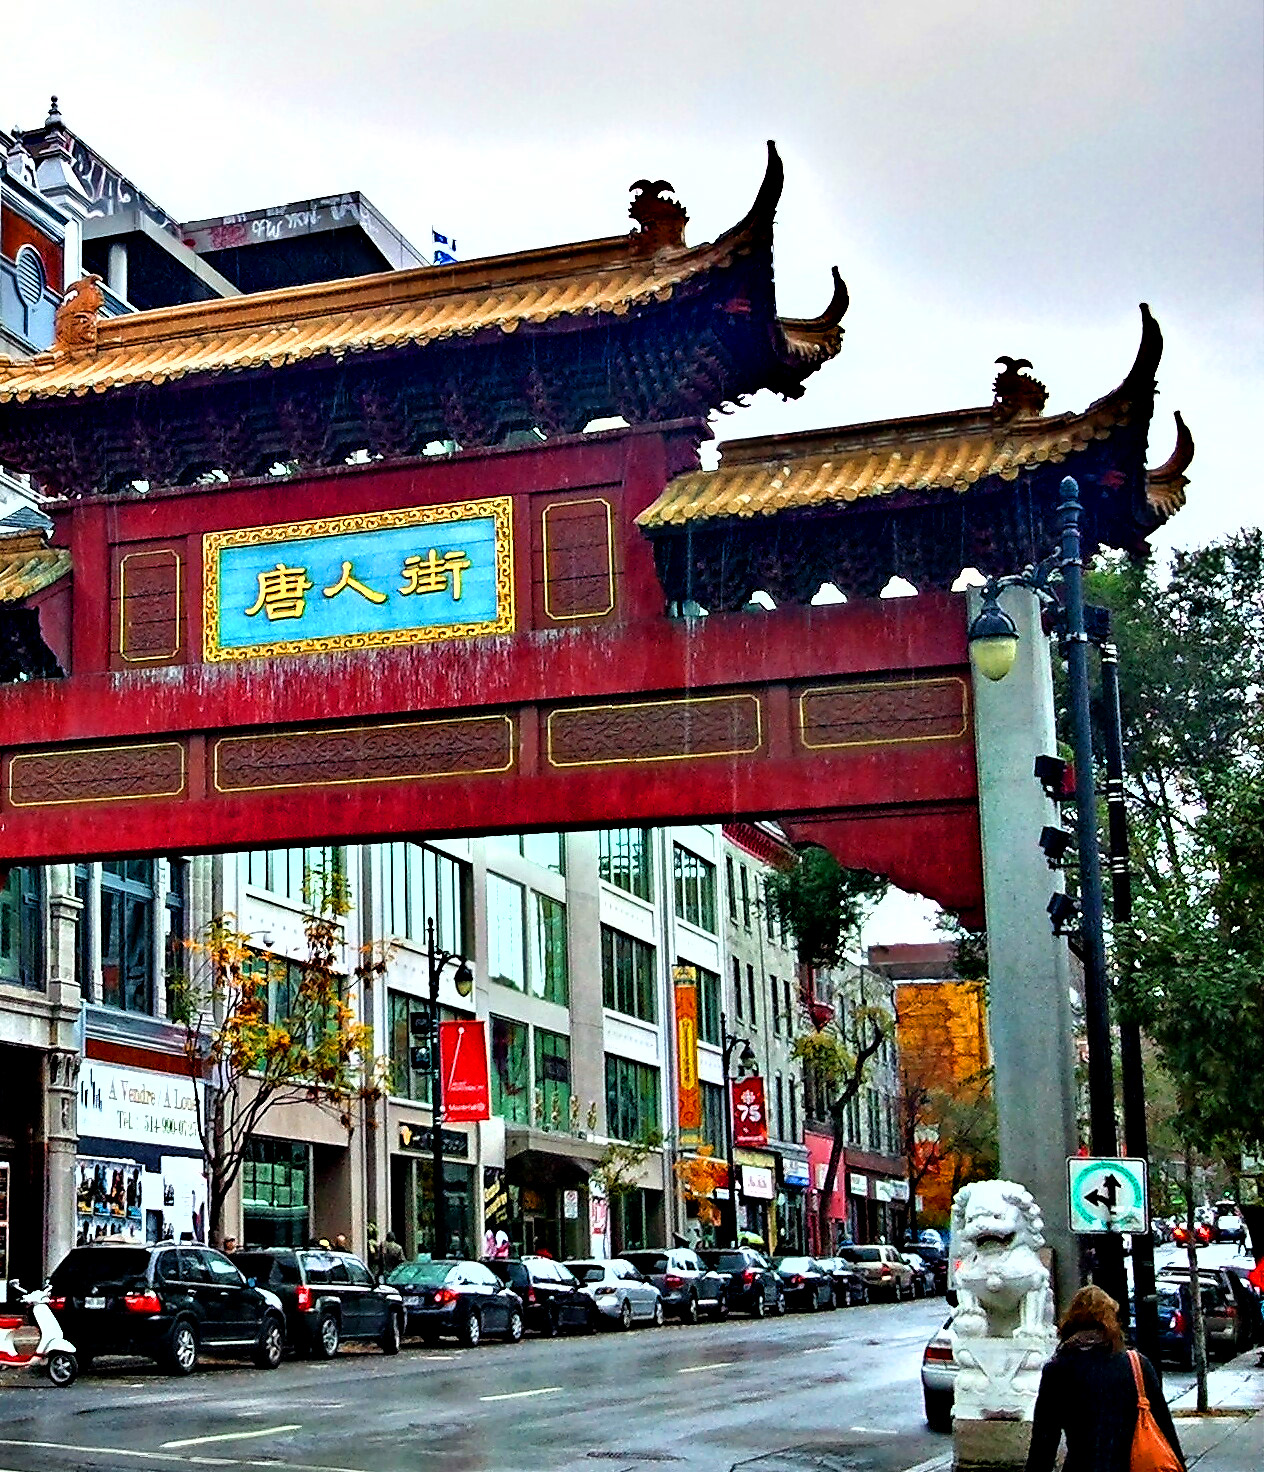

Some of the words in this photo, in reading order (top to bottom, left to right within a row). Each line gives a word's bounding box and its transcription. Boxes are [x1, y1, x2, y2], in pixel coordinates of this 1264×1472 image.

[244, 548, 471, 621] 唐人街
[736, 1104, 762, 1123] 75
